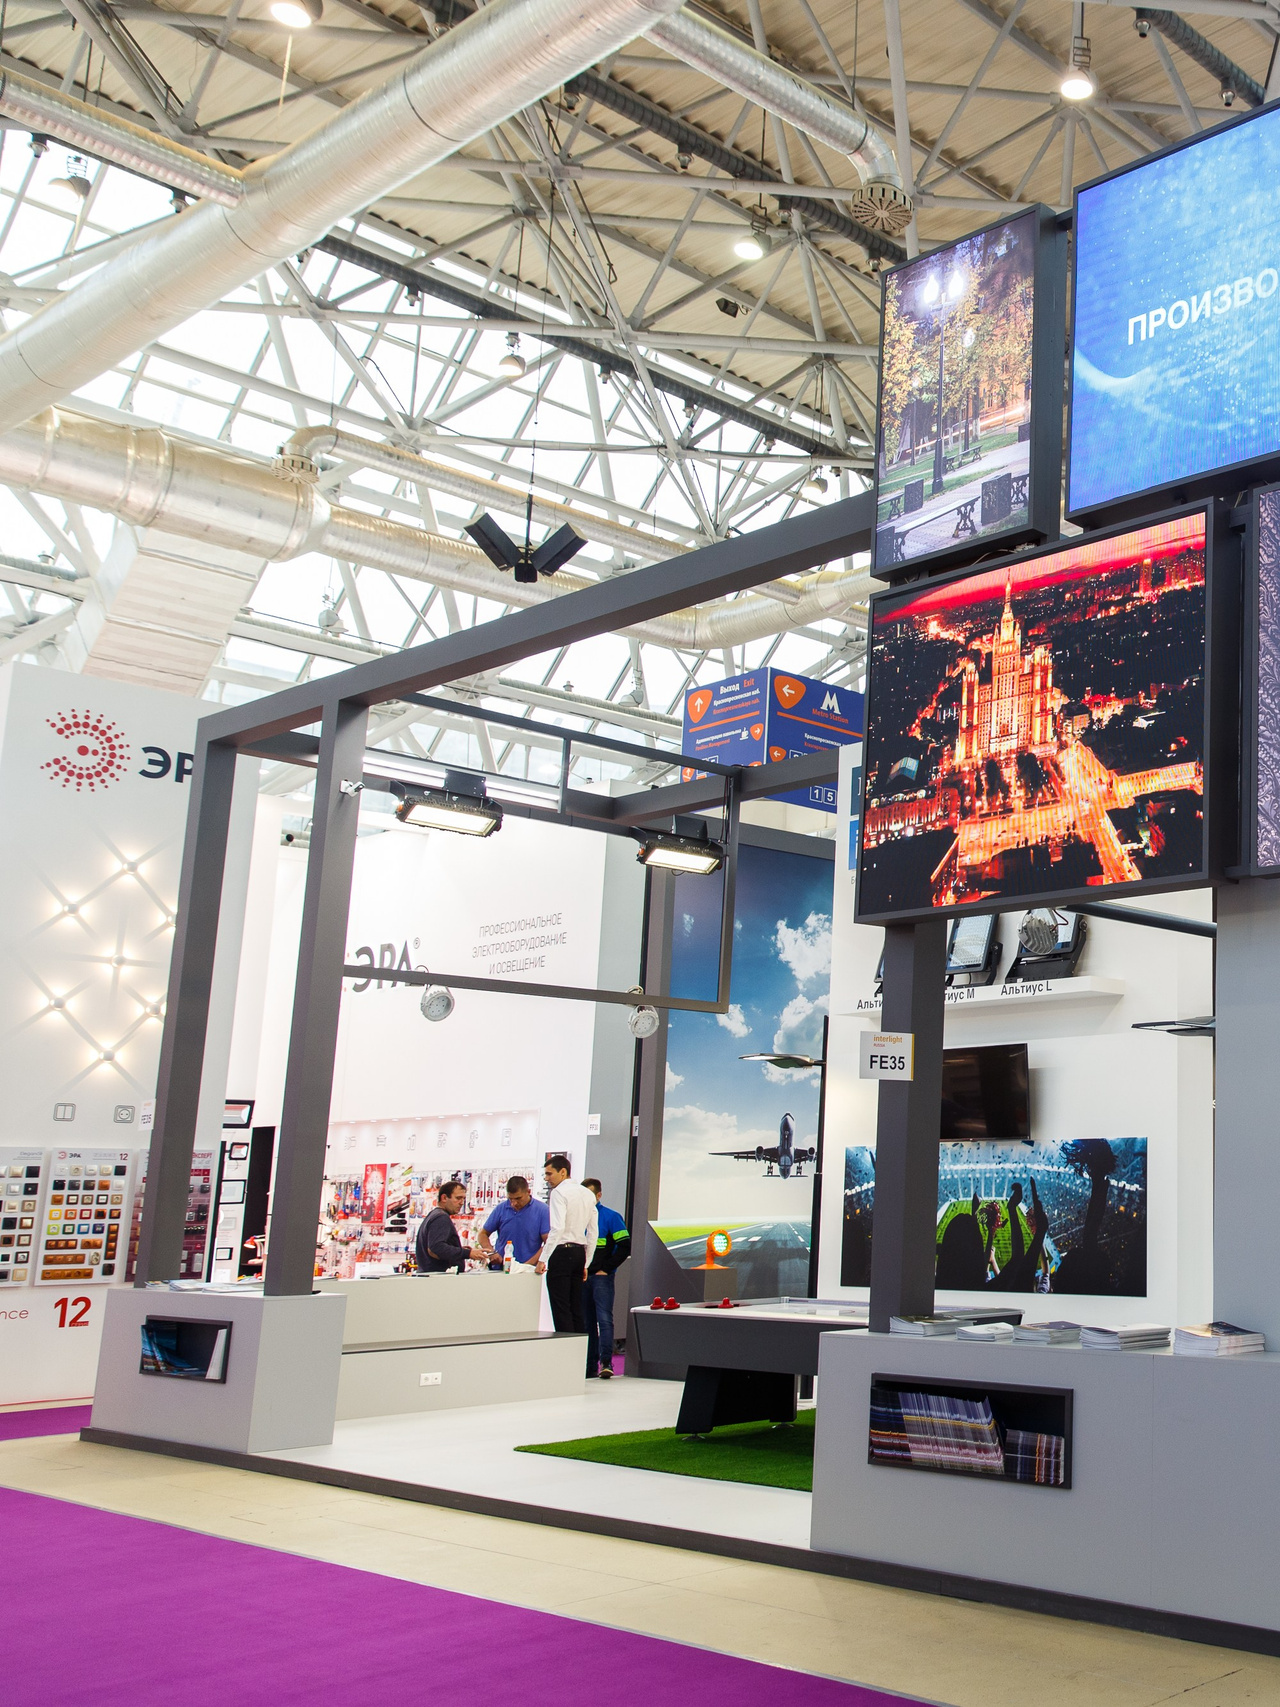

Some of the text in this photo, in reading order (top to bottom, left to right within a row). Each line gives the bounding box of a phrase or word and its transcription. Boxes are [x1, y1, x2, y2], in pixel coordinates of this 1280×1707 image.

[719, 678, 755, 694] Выход Exit
[812, 708, 849, 724] Metro Station
[138, 746, 194, 783] ЭР
[827, 791, 834, 801] 5
[478, 912, 563, 938] ПРОФЕССИОНАЛЬНОЕ
[471, 931, 568, 958] ЭЛЕКТРООБОРУДОВАНИЕ
[489, 955, 546, 975] И ОСВЕЩЕНИЕ
[1000, 980, 1053, 996] Альтиус L
[873, 1034, 903, 1044] interlight
[869, 1054, 905, 1070] FE35
[53, 1296, 92, 1328] 12
